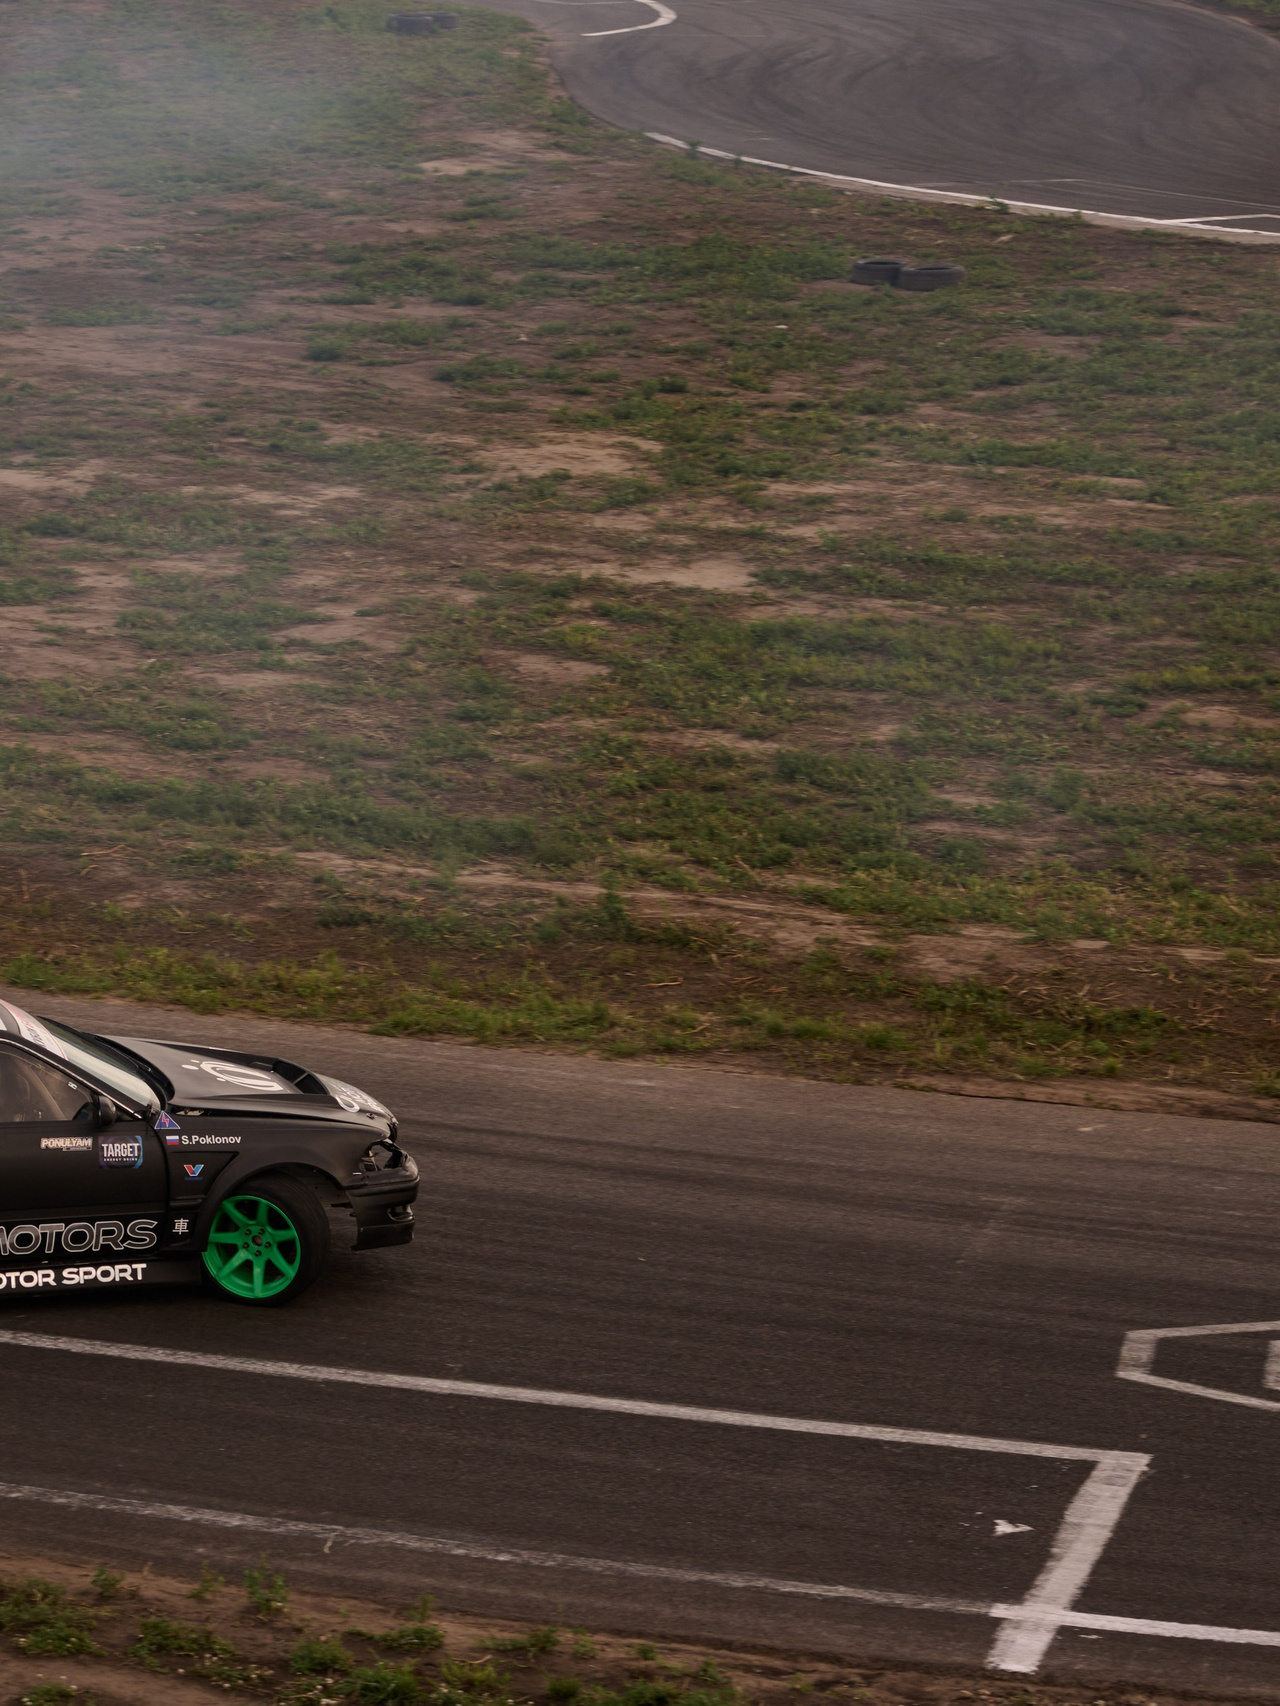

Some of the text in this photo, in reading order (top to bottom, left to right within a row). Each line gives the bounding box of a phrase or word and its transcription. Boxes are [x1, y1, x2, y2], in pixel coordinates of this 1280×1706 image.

[41, 1137, 92, 1149] PONULYAM
[181, 1134, 242, 1145] S.Poklonov
[101, 1142, 140, 1157] TARGET
[172, 1218, 189, 1235] 車
[62, 1263, 147, 1285] SPORT
